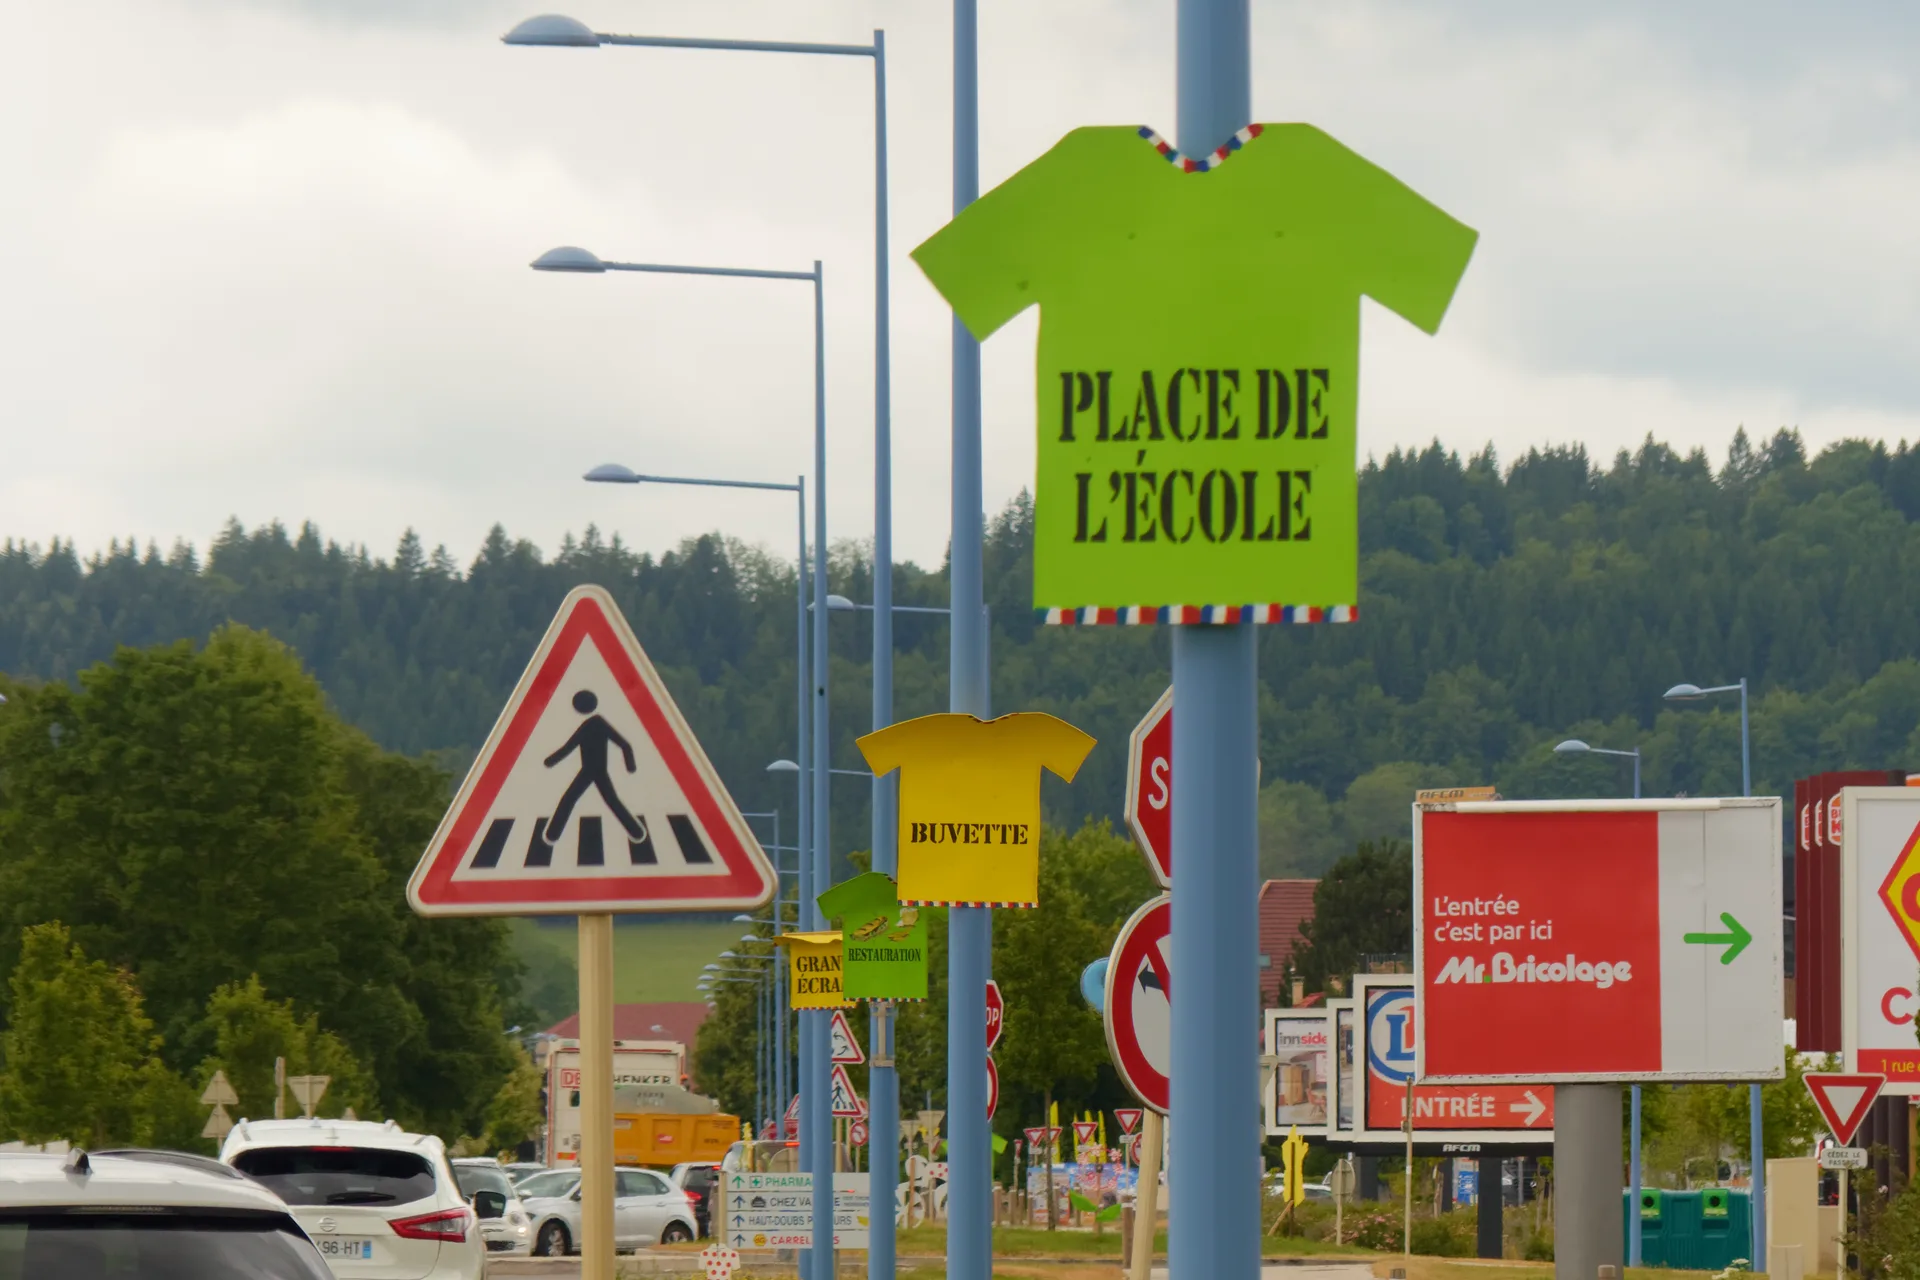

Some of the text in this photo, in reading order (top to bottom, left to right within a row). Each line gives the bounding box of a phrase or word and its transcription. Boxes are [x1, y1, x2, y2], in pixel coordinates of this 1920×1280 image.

[1058, 367, 1329, 442] PLACE DE
[910, 822, 1029, 845] BUVETTE
[1434, 894, 1520, 917] L'entrée
[1434, 919, 1553, 945] c'est par ici
[848, 948, 922, 962] RESTAURATION
[796, 955, 843, 972] GRAN
[796, 973, 843, 993] ÉCRA
[1891, 1061, 1915, 1073] rue
[612, 1075, 671, 1085] HENKER
[765, 1176, 812, 1187] PHARMA
[769, 1197, 797, 1207] CHEZ
[799, 1197, 841, 1207] VAE
[807, 1215, 852, 1225] PURS
[770, 1236, 840, 1245] CARRELS
